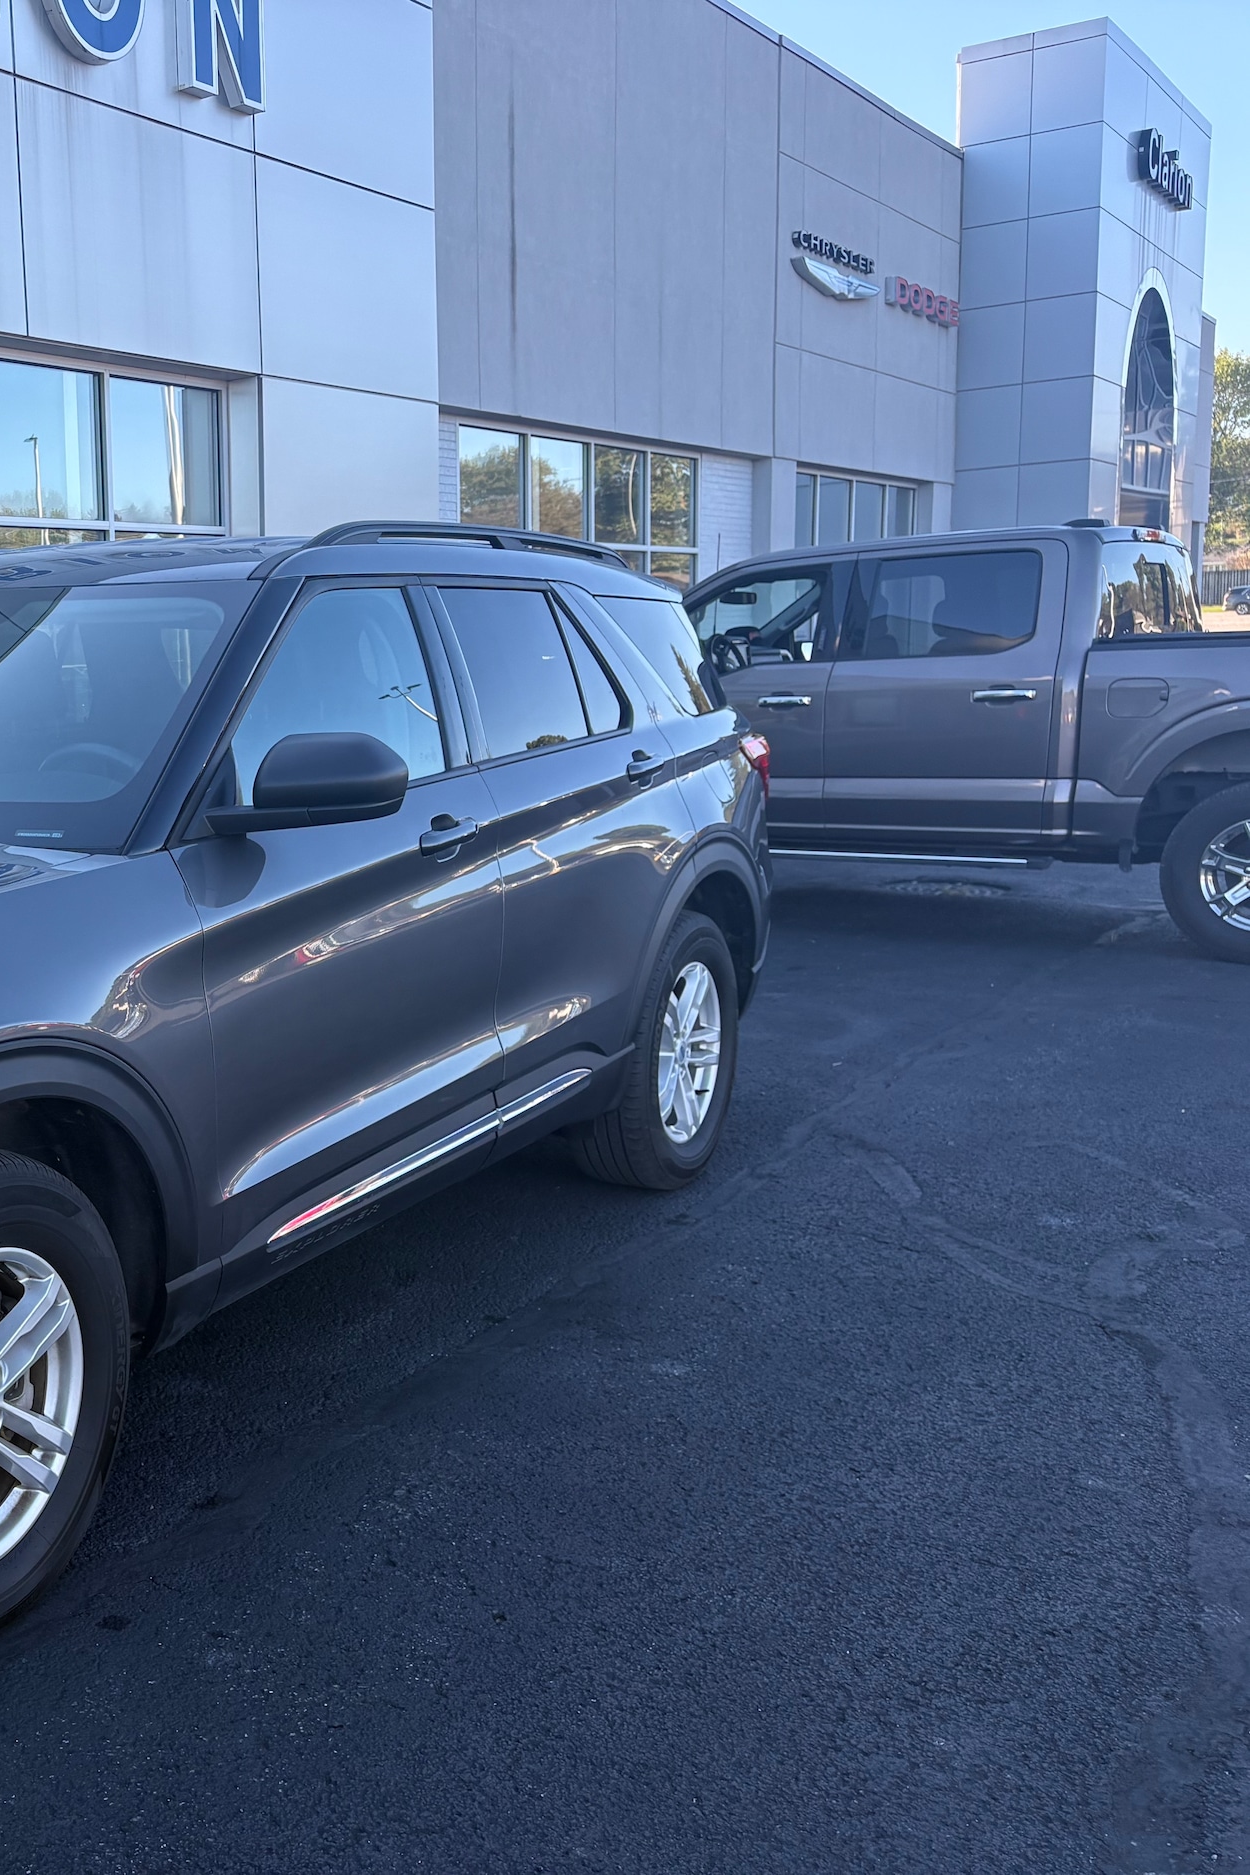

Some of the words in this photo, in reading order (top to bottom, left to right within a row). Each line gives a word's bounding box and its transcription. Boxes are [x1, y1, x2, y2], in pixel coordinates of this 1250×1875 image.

[1139, 127, 1194, 210] Clarion
[792, 229, 876, 274] CHRYSLER
[888, 275, 960, 327] DODGE
